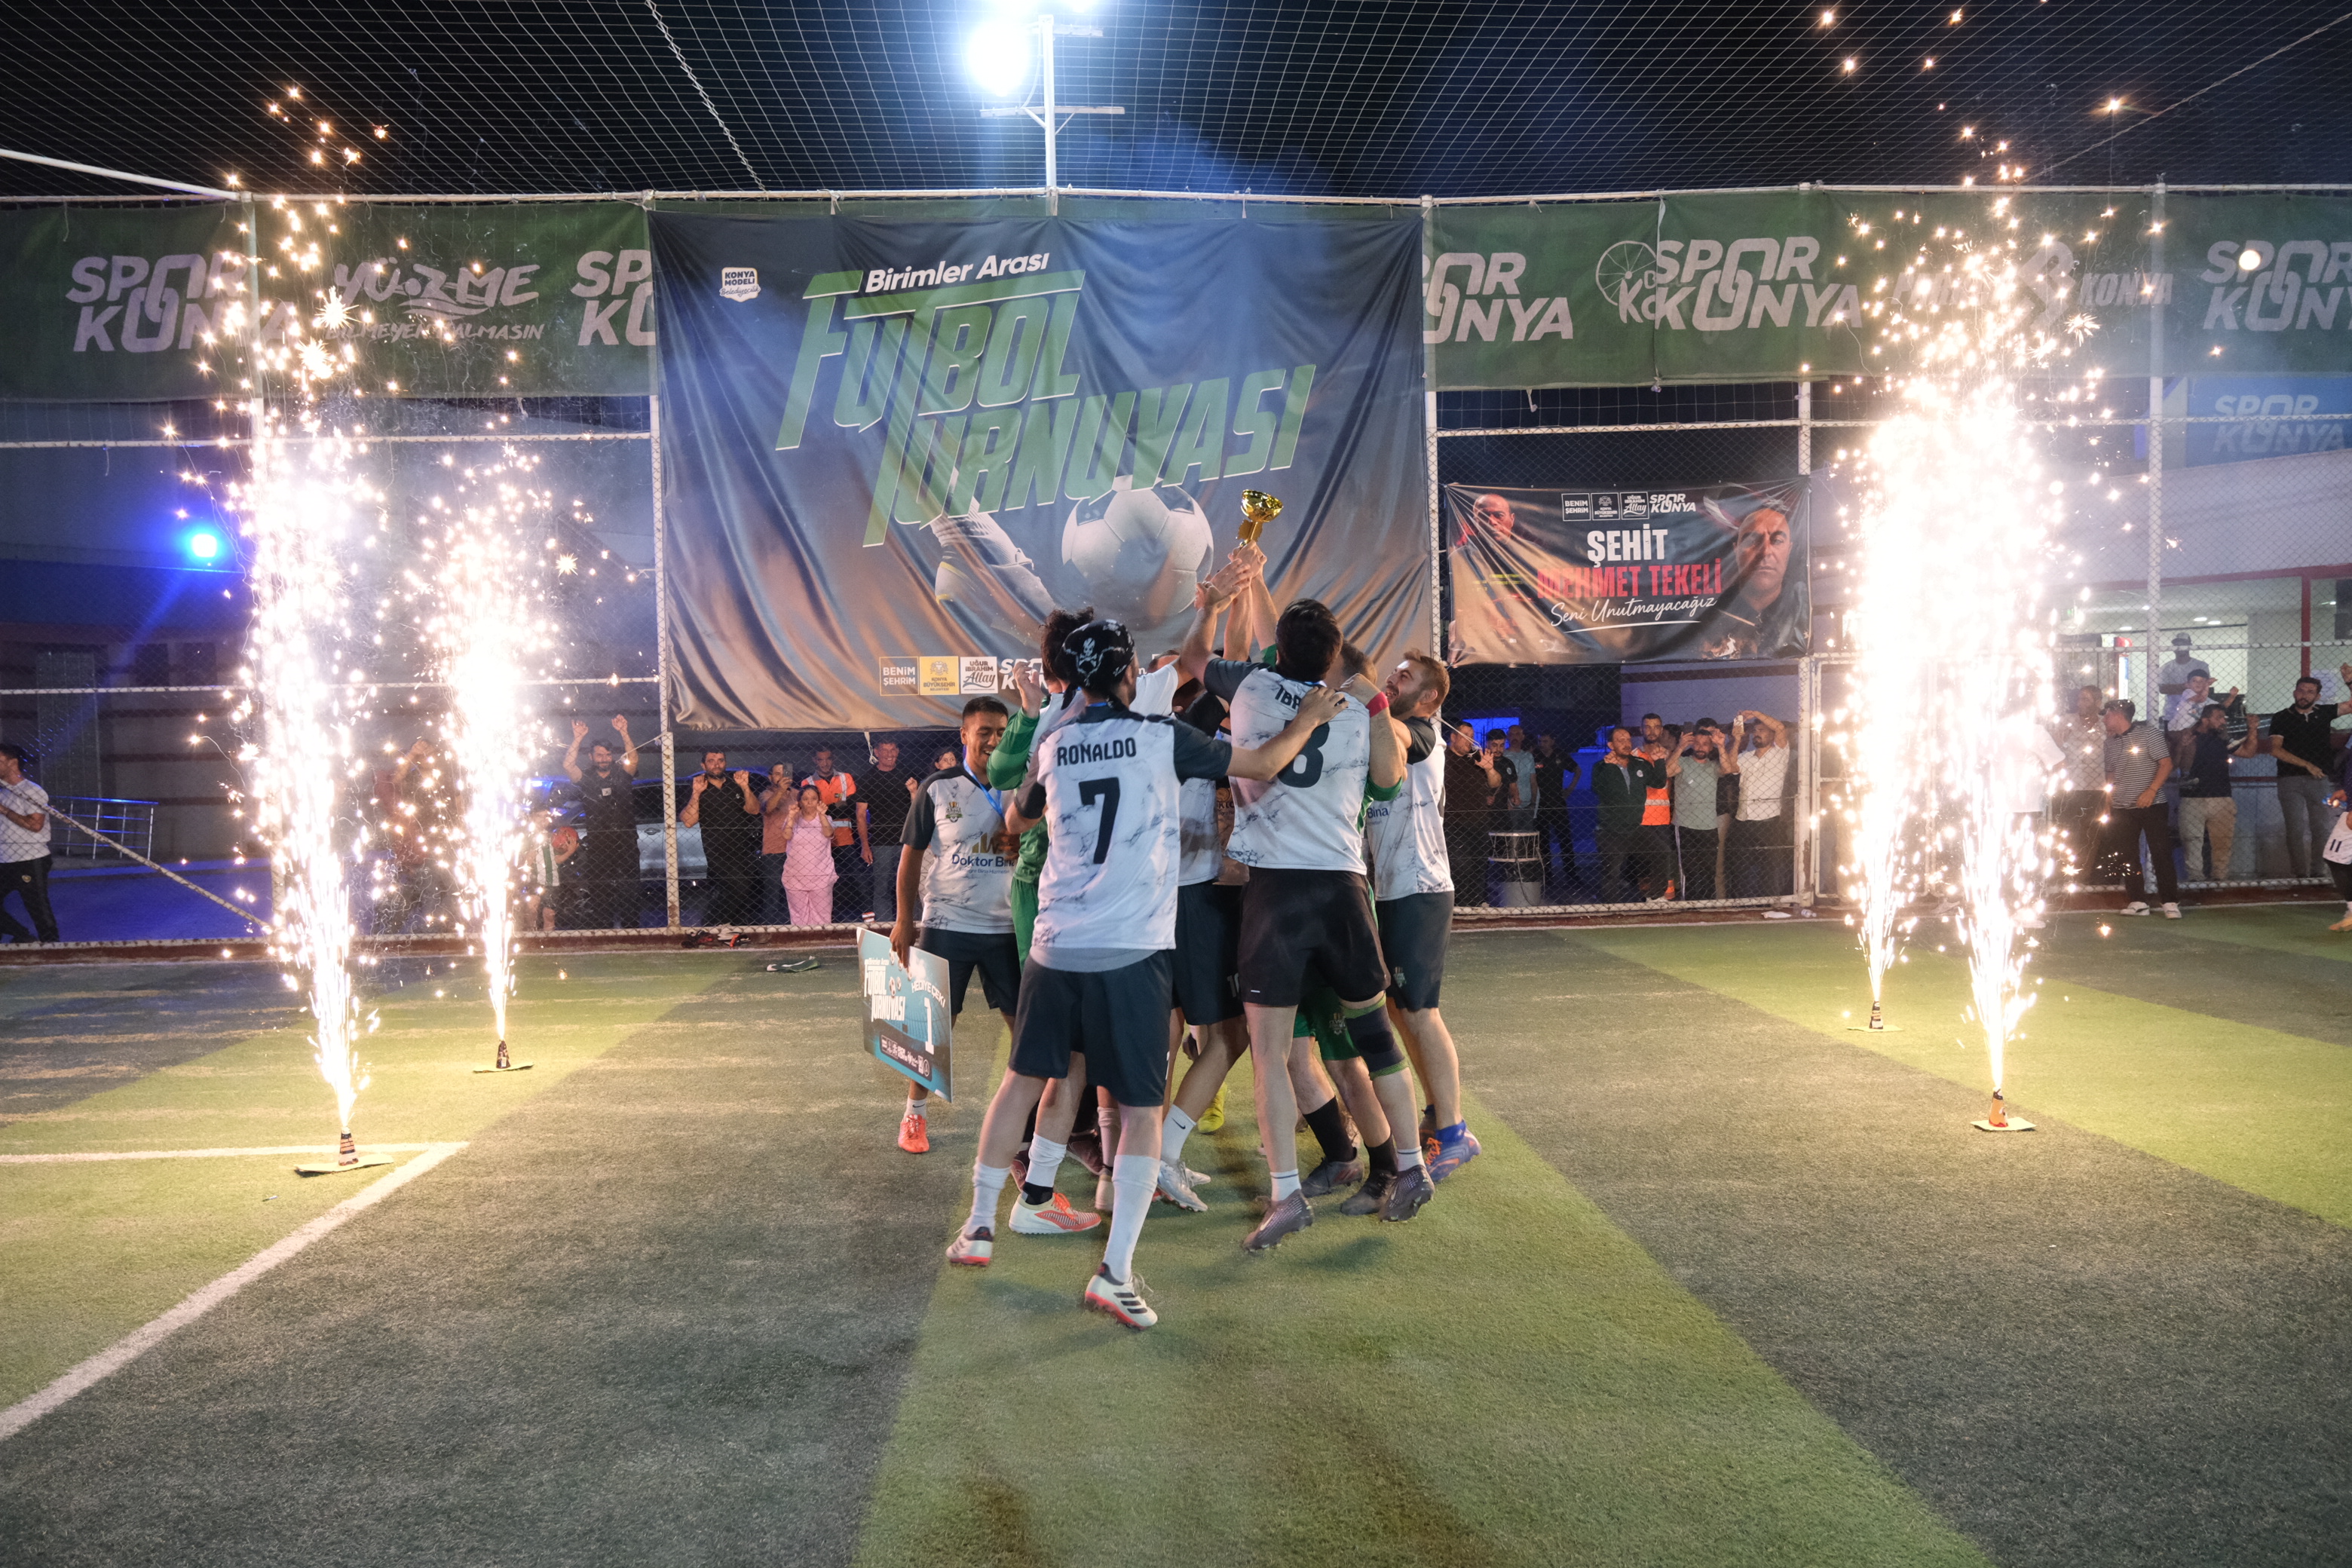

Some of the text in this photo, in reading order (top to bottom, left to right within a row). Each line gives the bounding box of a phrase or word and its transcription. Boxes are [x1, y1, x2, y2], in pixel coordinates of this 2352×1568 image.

[724, 271, 755, 280] KONYA
[865, 253, 1049, 292] Birimler Arası
[1656, 236, 1820, 303] SPOR
[65, 251, 250, 323] SPOR
[1655, 270, 1863, 330] KONYA
[1423, 283, 1573, 344] ONYA
[775, 269, 1086, 451] FUTBOL
[1649, 494, 1686, 507] SPOR
[1651, 501, 1697, 513] KONYA
[1587, 523, 1668, 568] ŞEHİT
[1537, 558, 1723, 599] MEHMET TEKELİ
[1551, 596, 1718, 626] Seni Unutmayacağız
[883, 666, 916, 675] BENİM
[883, 677, 916, 686] ŞEHRİM
[963, 672, 996, 688] Altay
[1057, 737, 1137, 767] RONALDO
[1079, 777, 1121, 865] 7
[1367, 807, 1389, 819] Bina
[952, 854, 994, 867] Doktor
[2329, 838, 2343, 853] 11
